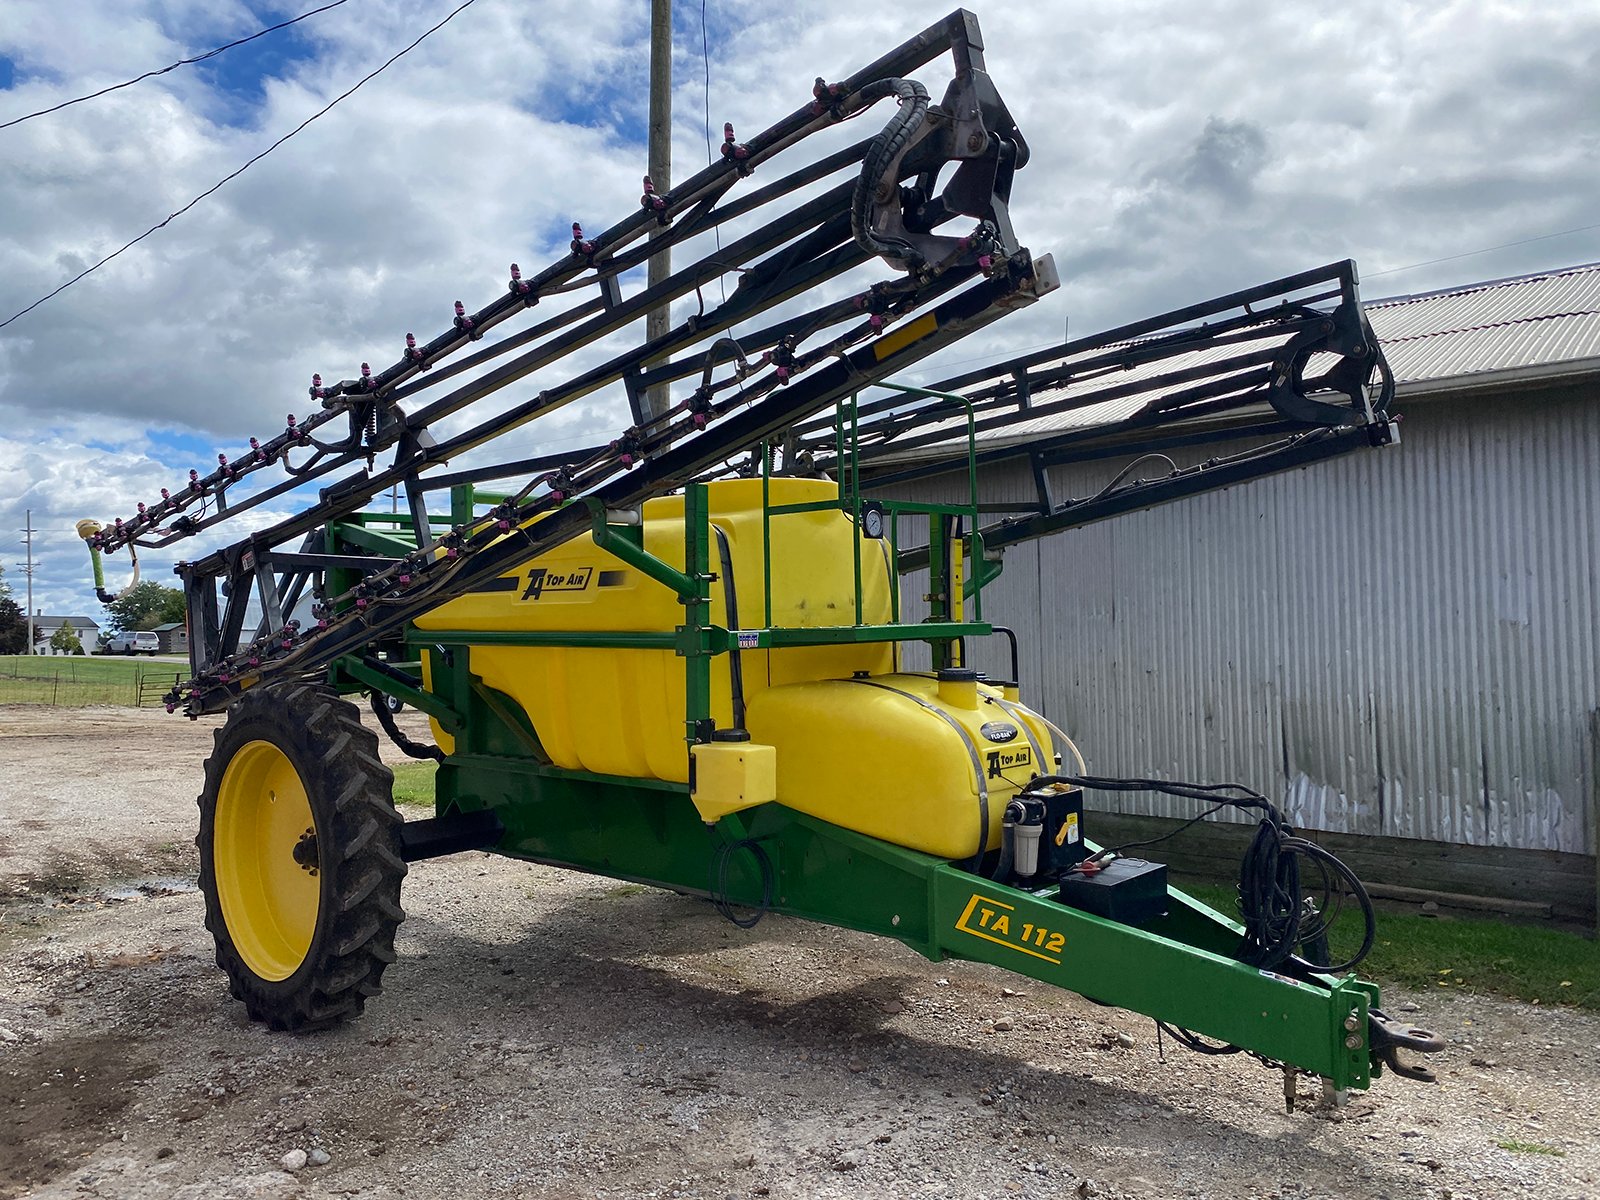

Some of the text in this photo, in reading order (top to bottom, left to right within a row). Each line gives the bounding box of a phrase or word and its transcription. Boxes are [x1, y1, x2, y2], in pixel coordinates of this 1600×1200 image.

[546, 574, 565, 586] TOP
[566, 573, 584, 585] AIR
[1001, 755, 1013, 765] TOP
[1015, 753, 1027, 763] AIR
[979, 908, 1066, 953] TA 112
